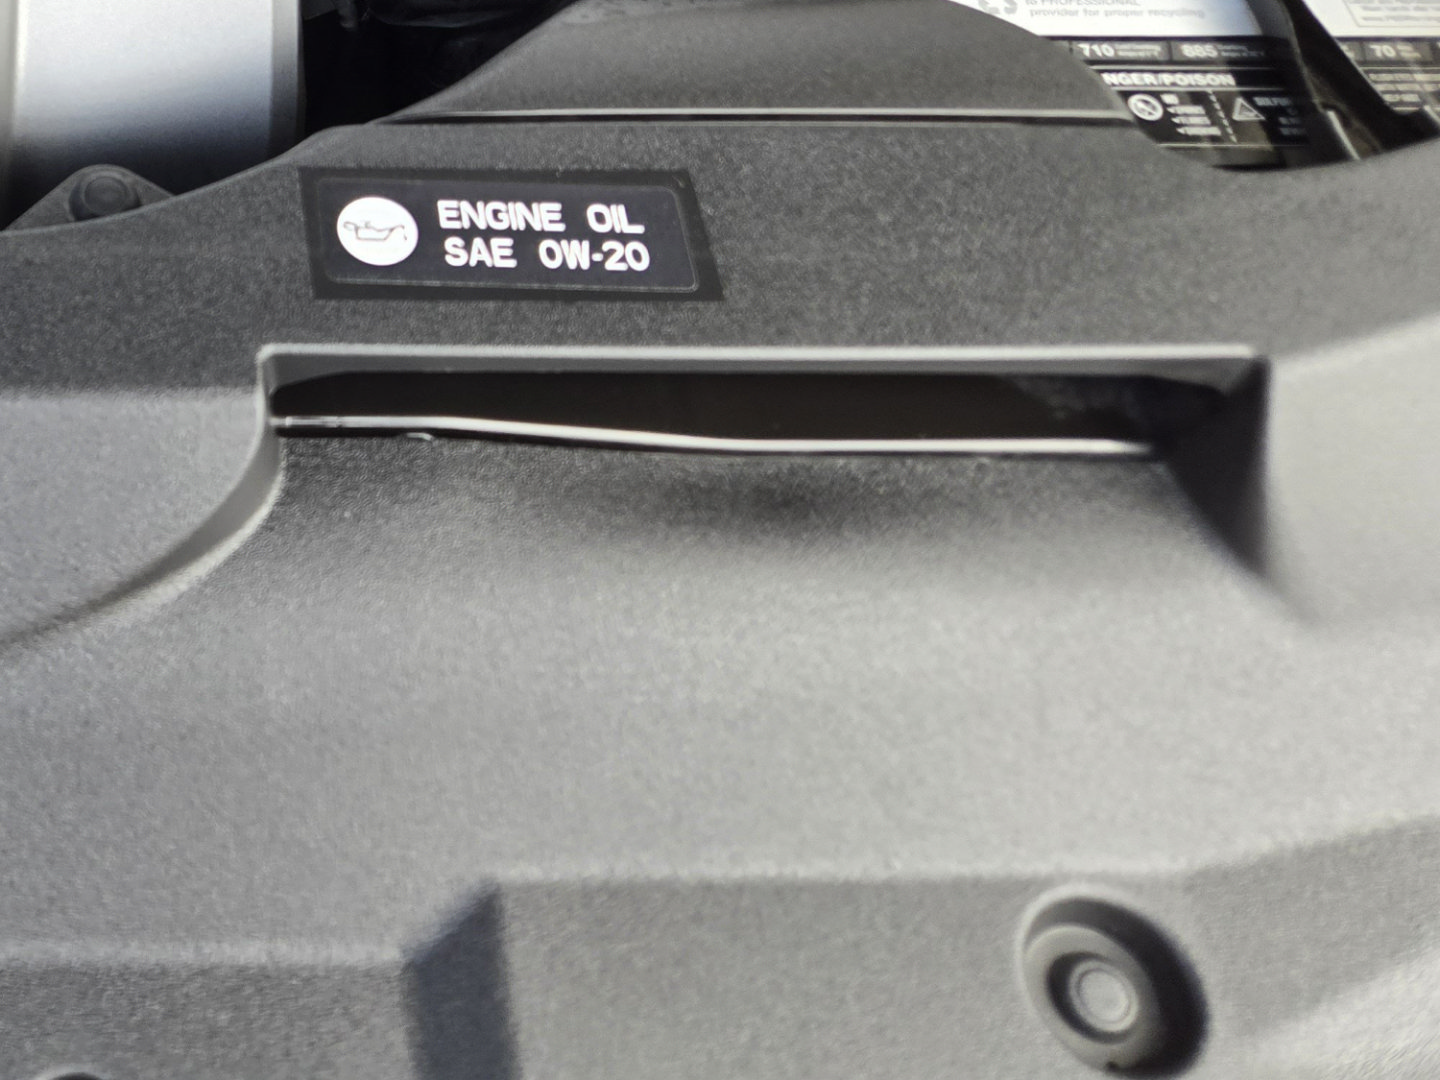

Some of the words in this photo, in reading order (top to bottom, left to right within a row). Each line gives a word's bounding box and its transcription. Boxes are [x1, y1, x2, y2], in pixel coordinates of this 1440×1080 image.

[1082, 8, 1100, 17] for
[1076, 42, 1116, 59] 710
[1368, 44, 1397, 58] 70
[1100, 72, 1236, 87] NGER/POISON
[436, 199, 566, 234] ENGINE
[585, 203, 646, 235] OIL
[442, 236, 518, 269] SAE
[538, 239, 651, 273] 0W-20
